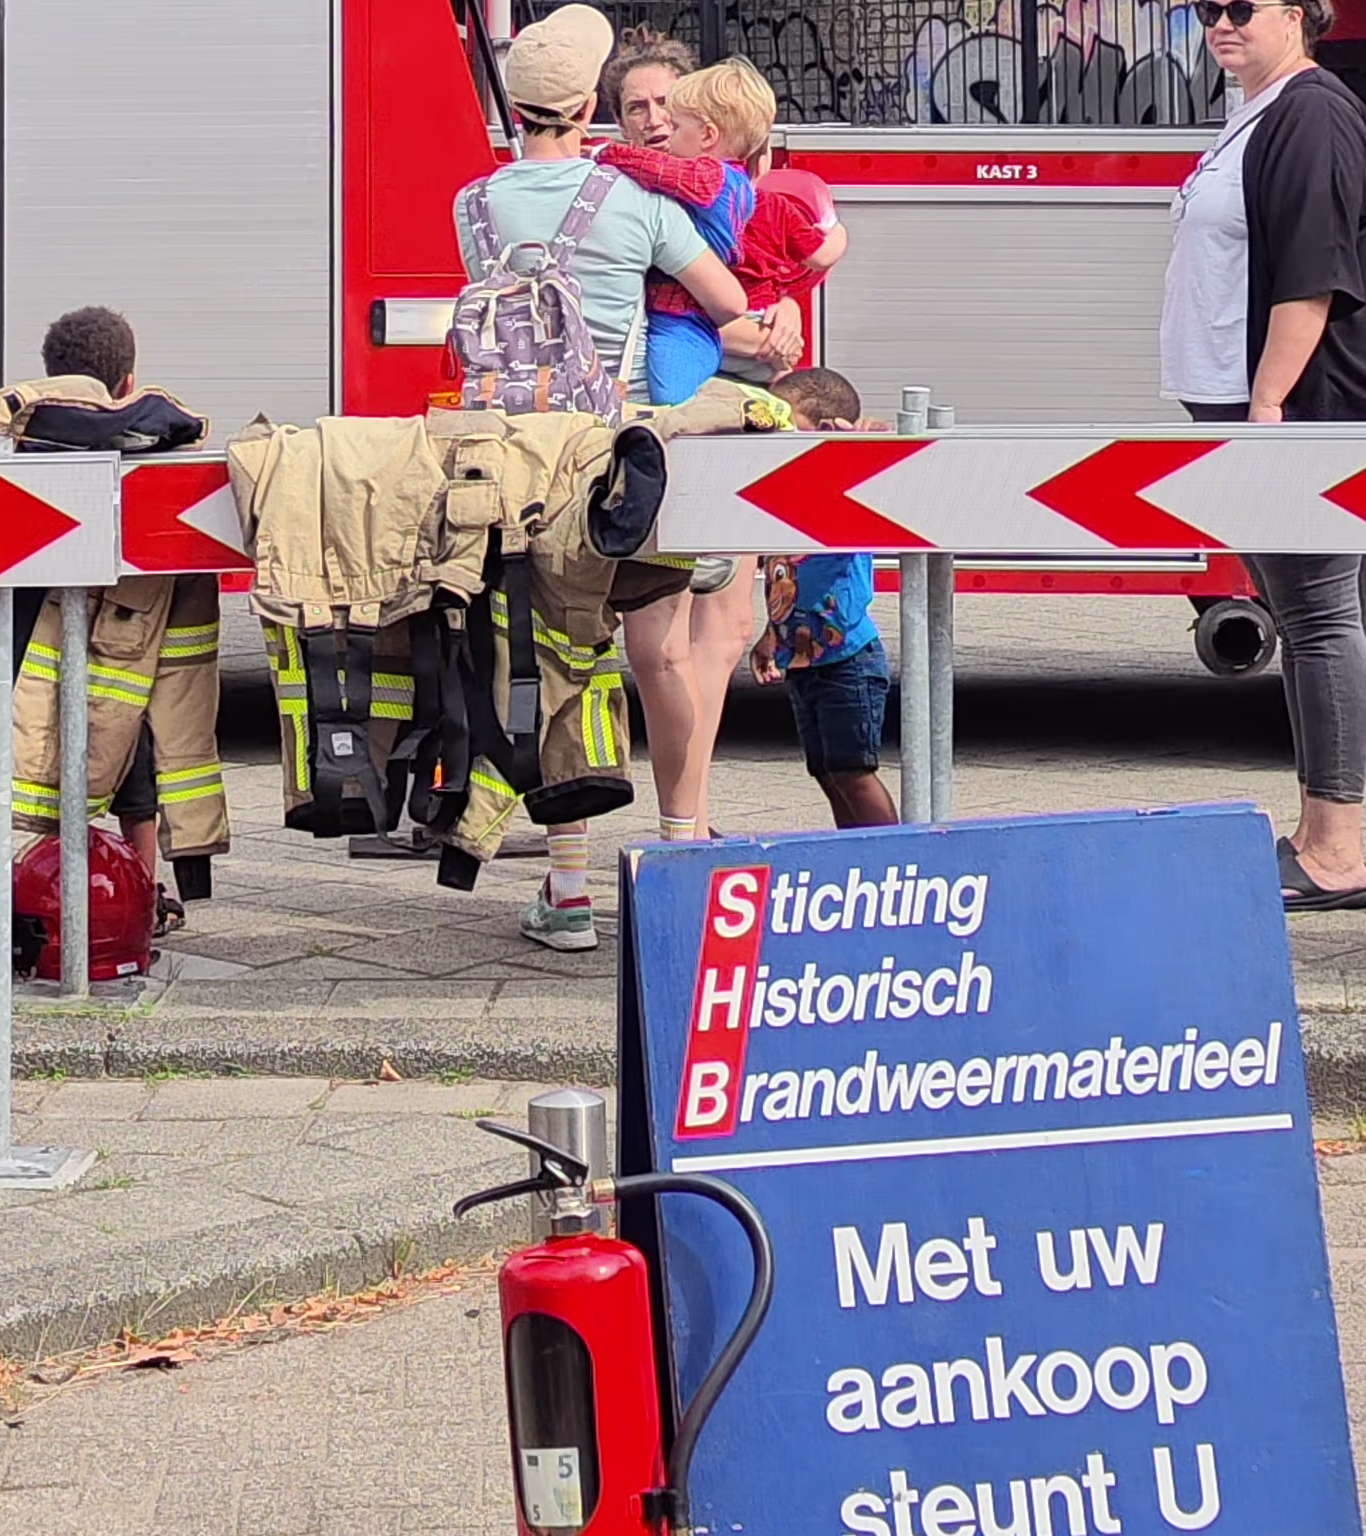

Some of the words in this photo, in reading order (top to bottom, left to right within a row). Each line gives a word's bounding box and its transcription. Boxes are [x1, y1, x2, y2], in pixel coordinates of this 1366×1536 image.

[976, 164, 1023, 179] KAST
[1026, 164, 1038, 179] 3
[713, 864, 988, 939] Stichting
[697, 951, 993, 1032] Historisch
[684, 1021, 1283, 1128] Brandweermaterieel
[832, 1216, 1003, 1309] Met
[1036, 1222, 1165, 1292] uw
[826, 1336, 1208, 1434] aankoop
[558, 1455, 573, 1479] 5
[840, 1453, 1122, 1536] steunt
[1153, 1443, 1222, 1531] U
[533, 1504, 541, 1522] 5
